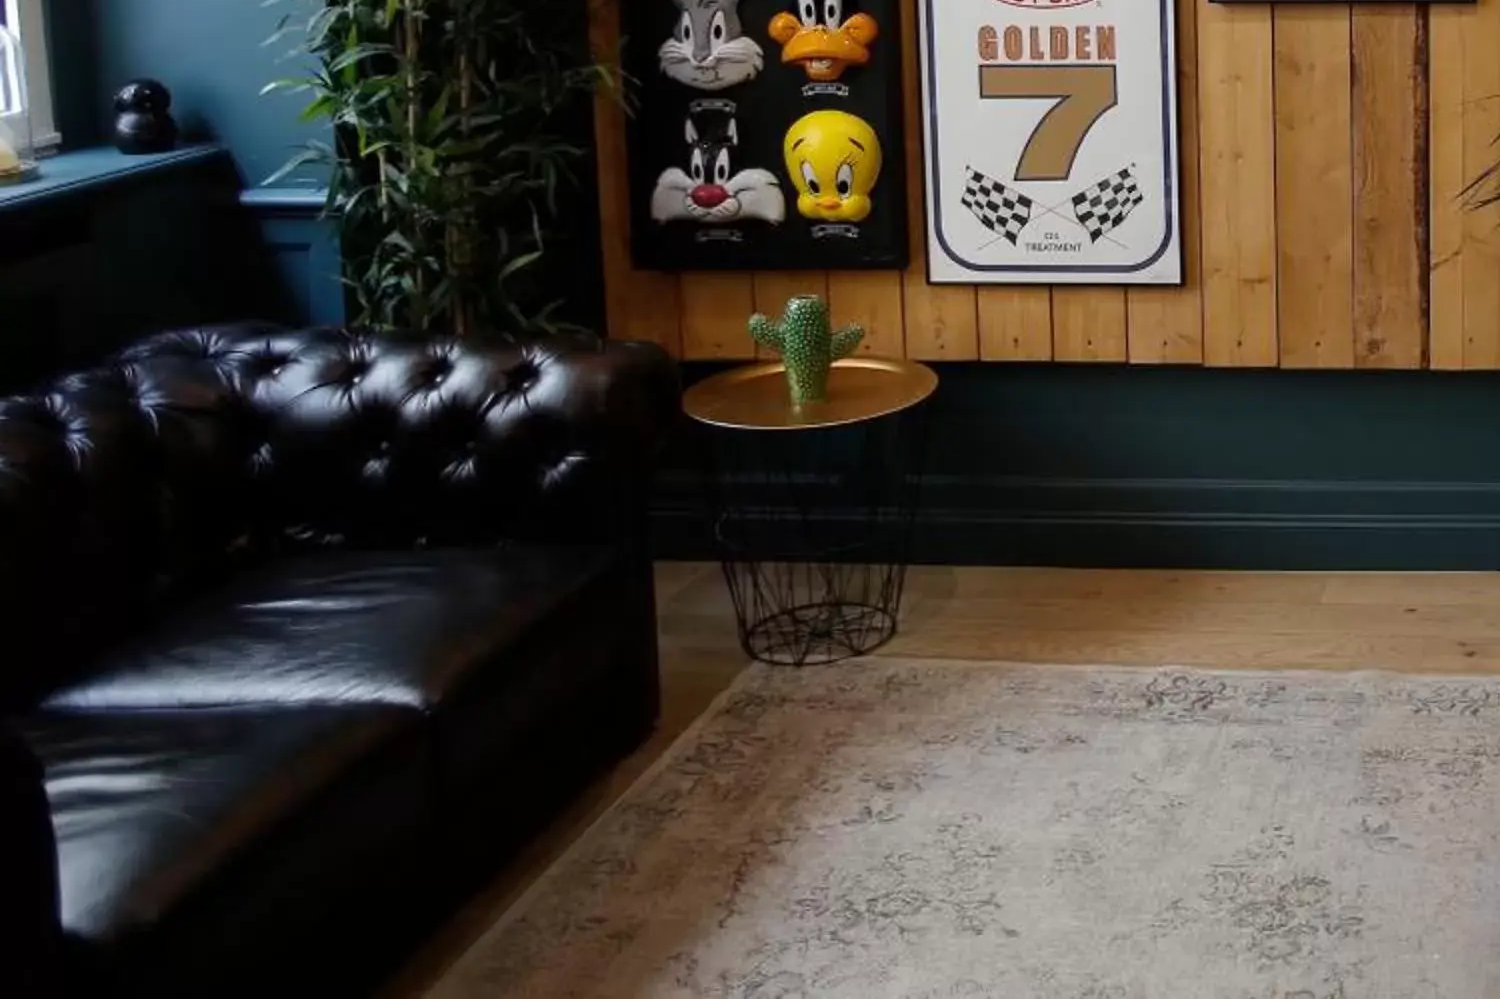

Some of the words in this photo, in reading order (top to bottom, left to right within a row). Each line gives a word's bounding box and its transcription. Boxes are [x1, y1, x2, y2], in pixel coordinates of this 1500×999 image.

[977, 24, 1117, 61] GOLDEN
[978, 64, 1119, 182] 7
[1024, 242, 1082, 254] TREATMENT
